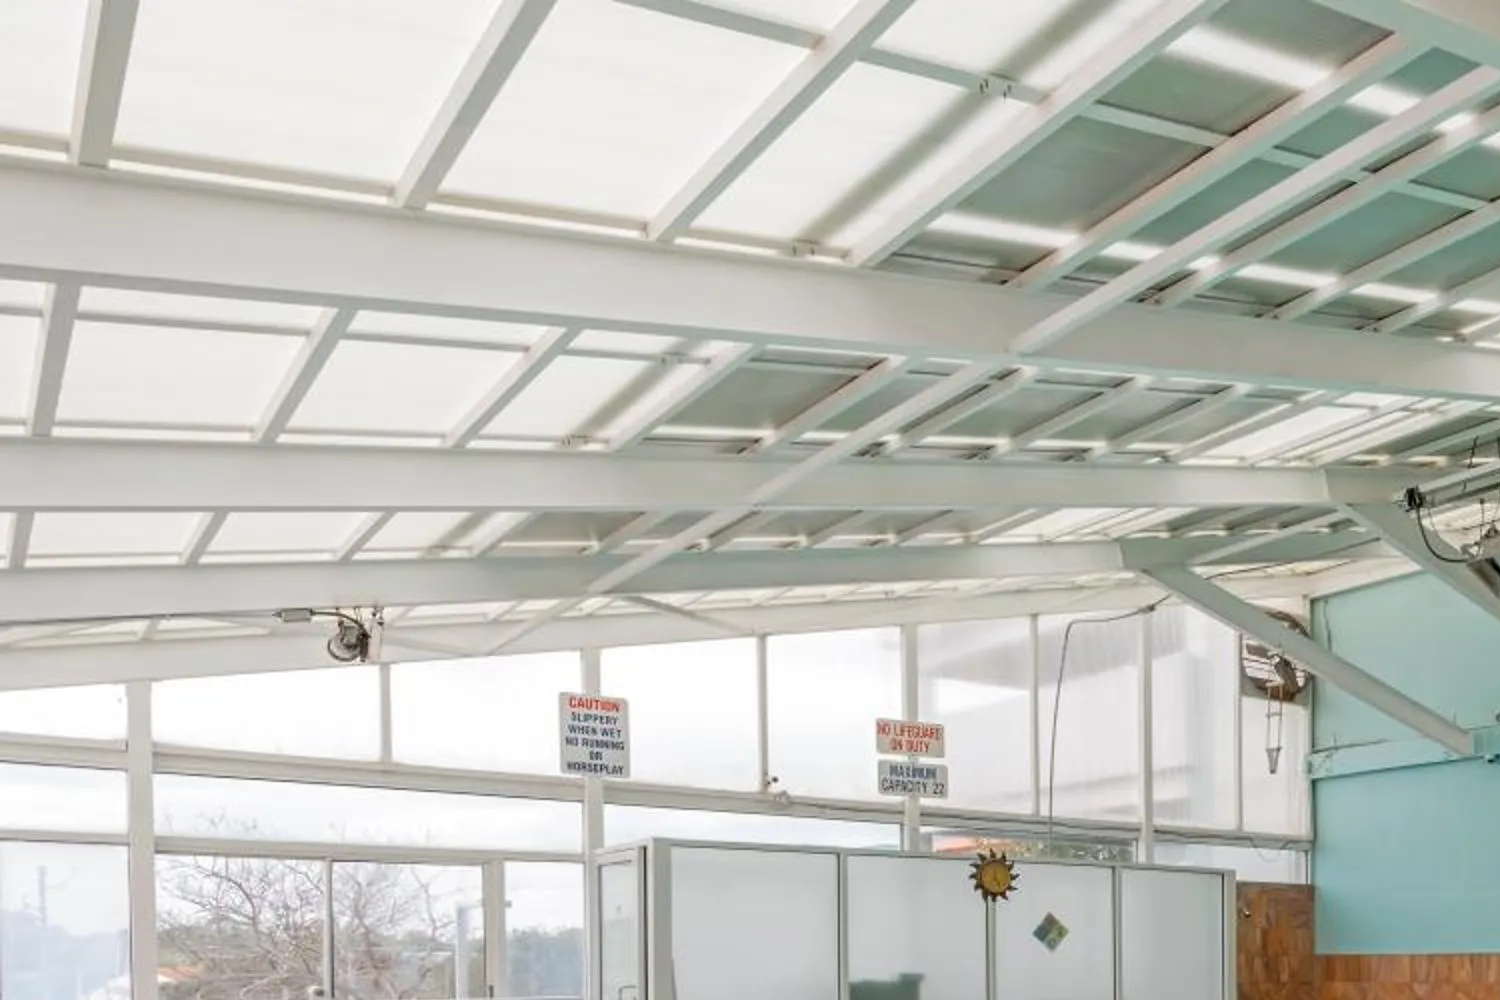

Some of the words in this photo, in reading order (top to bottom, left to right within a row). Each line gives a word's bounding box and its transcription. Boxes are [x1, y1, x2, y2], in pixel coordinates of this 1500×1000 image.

[569, 696, 621, 712] CAUTION
[571, 712, 618, 725] SLIPPERY
[568, 724, 597, 736] WHEN
[601, 727, 622, 739] WET
[566, 736, 579, 746] NO
[582, 739, 625, 751] RUNNING
[567, 761, 624, 775] HORSEPLAY
[881, 777, 928, 794] CAPACITY
[932, 784, 945, 795] 22
